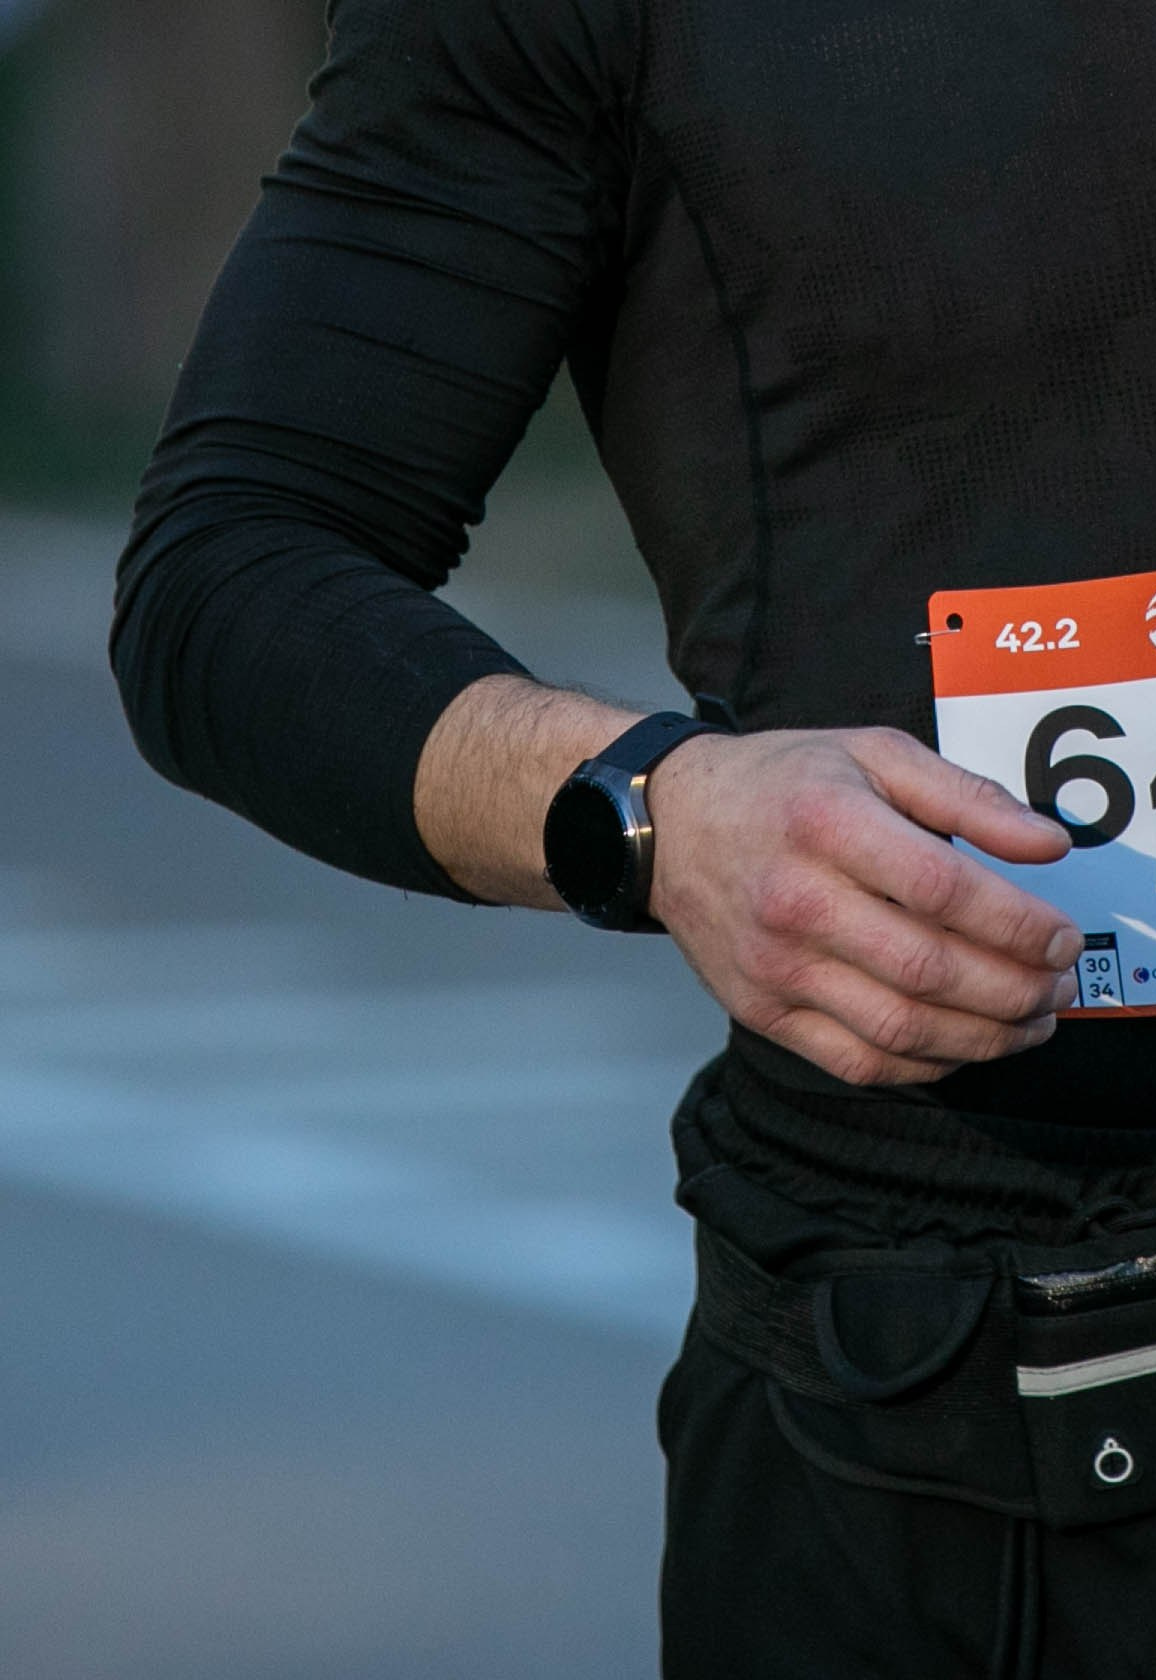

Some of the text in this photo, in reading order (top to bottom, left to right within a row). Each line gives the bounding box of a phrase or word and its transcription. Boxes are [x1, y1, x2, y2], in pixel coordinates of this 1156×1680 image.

[995, 618, 1080, 653] 42.2
[1085, 957, 1111, 974] 30
[1089, 983, 1115, 998] 34
